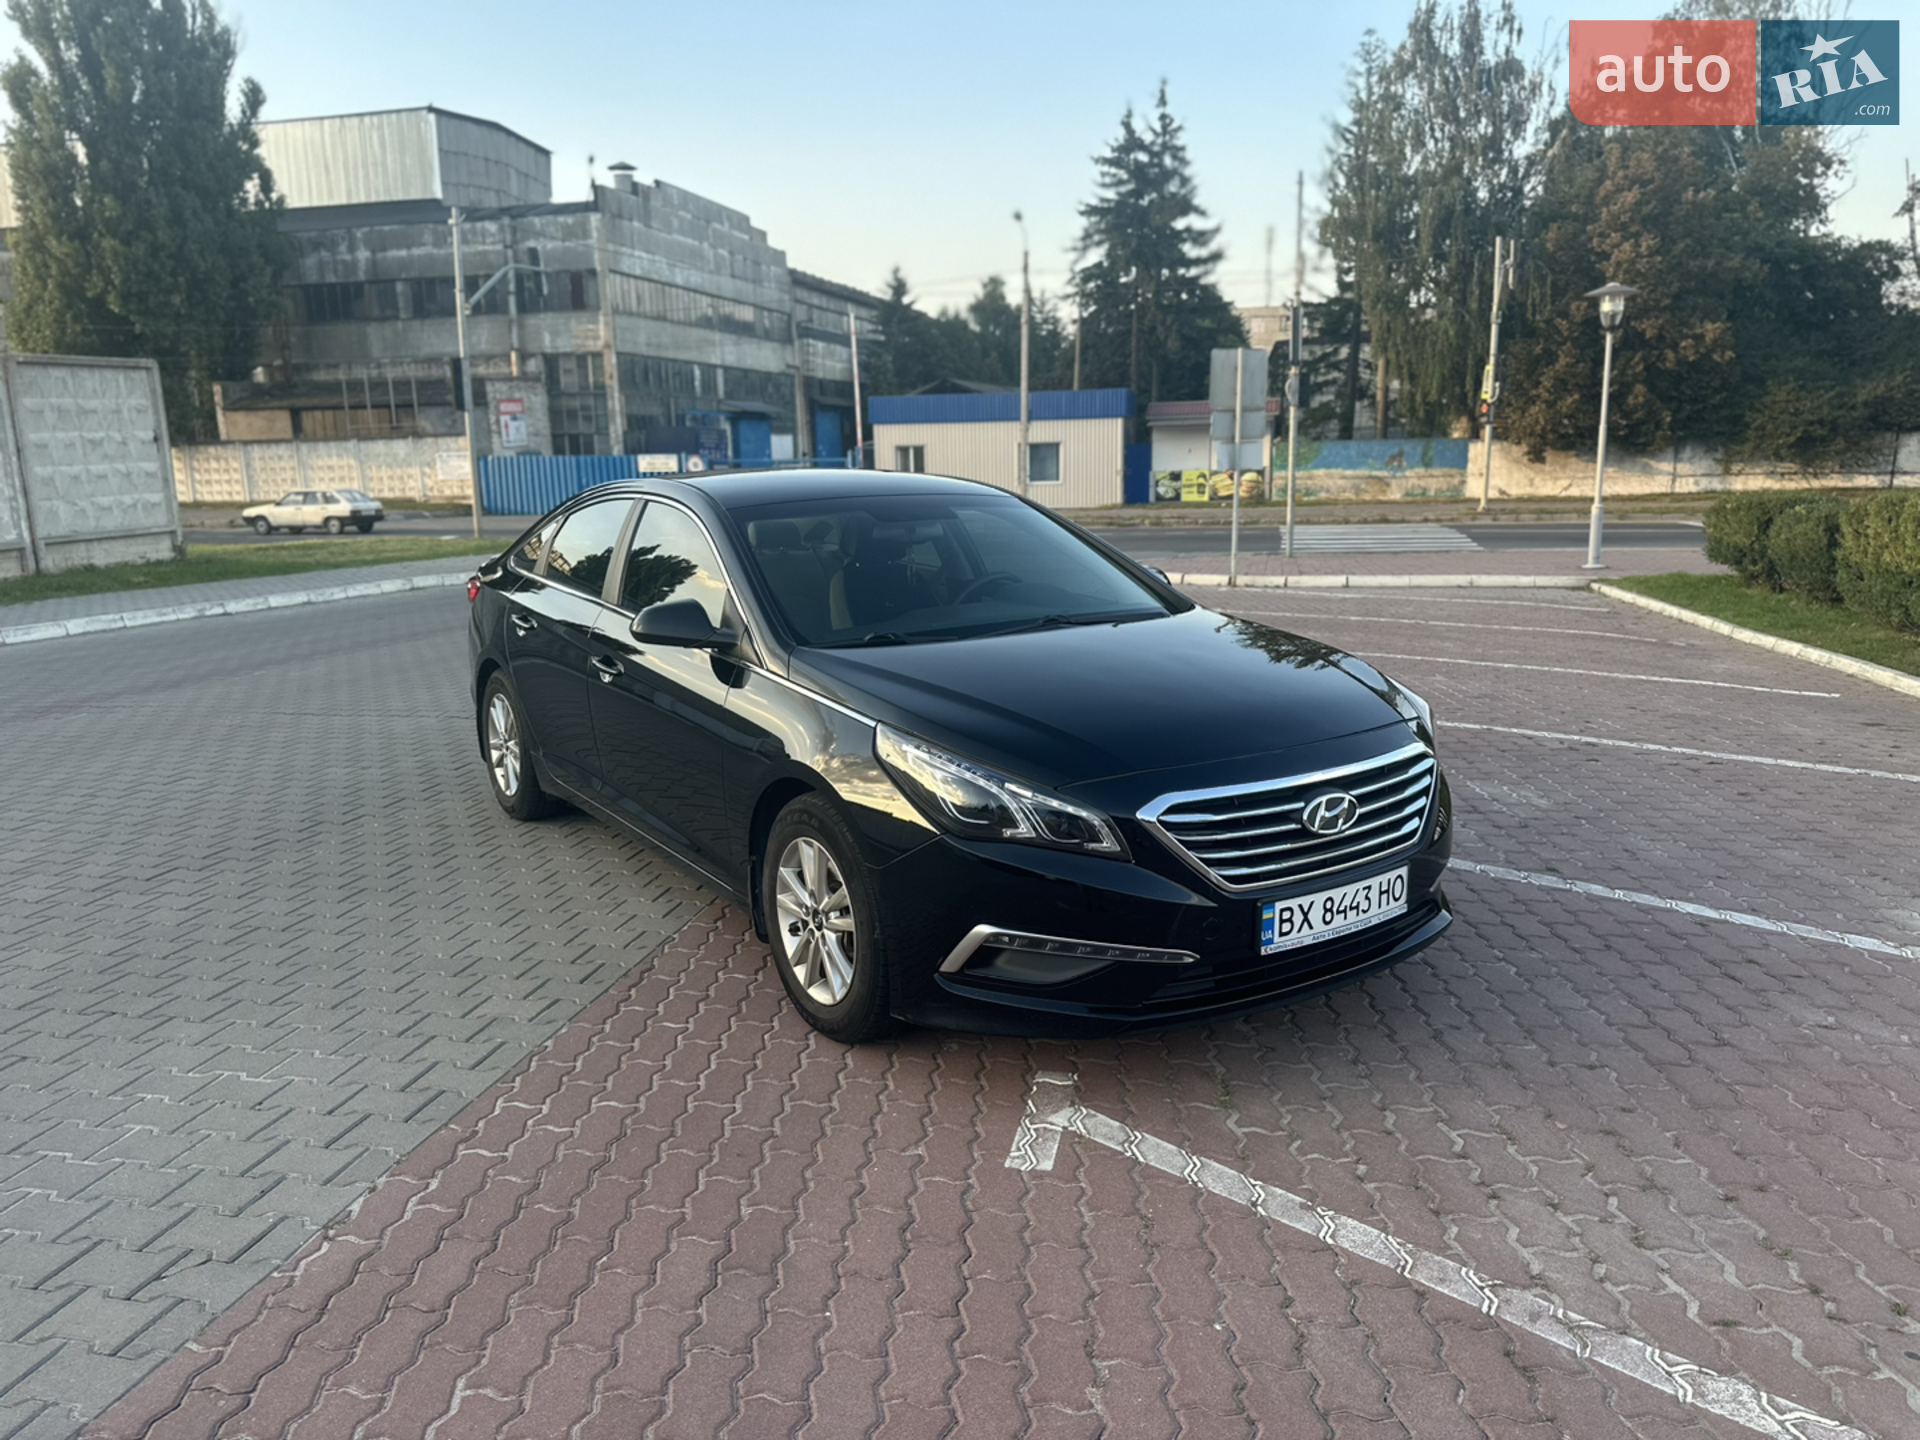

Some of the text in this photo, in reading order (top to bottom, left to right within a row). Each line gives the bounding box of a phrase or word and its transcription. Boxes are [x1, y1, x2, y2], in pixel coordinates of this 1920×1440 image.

[1278, 873, 1405, 938] BX 8443 HO
[1261, 930, 1273, 941] UA
